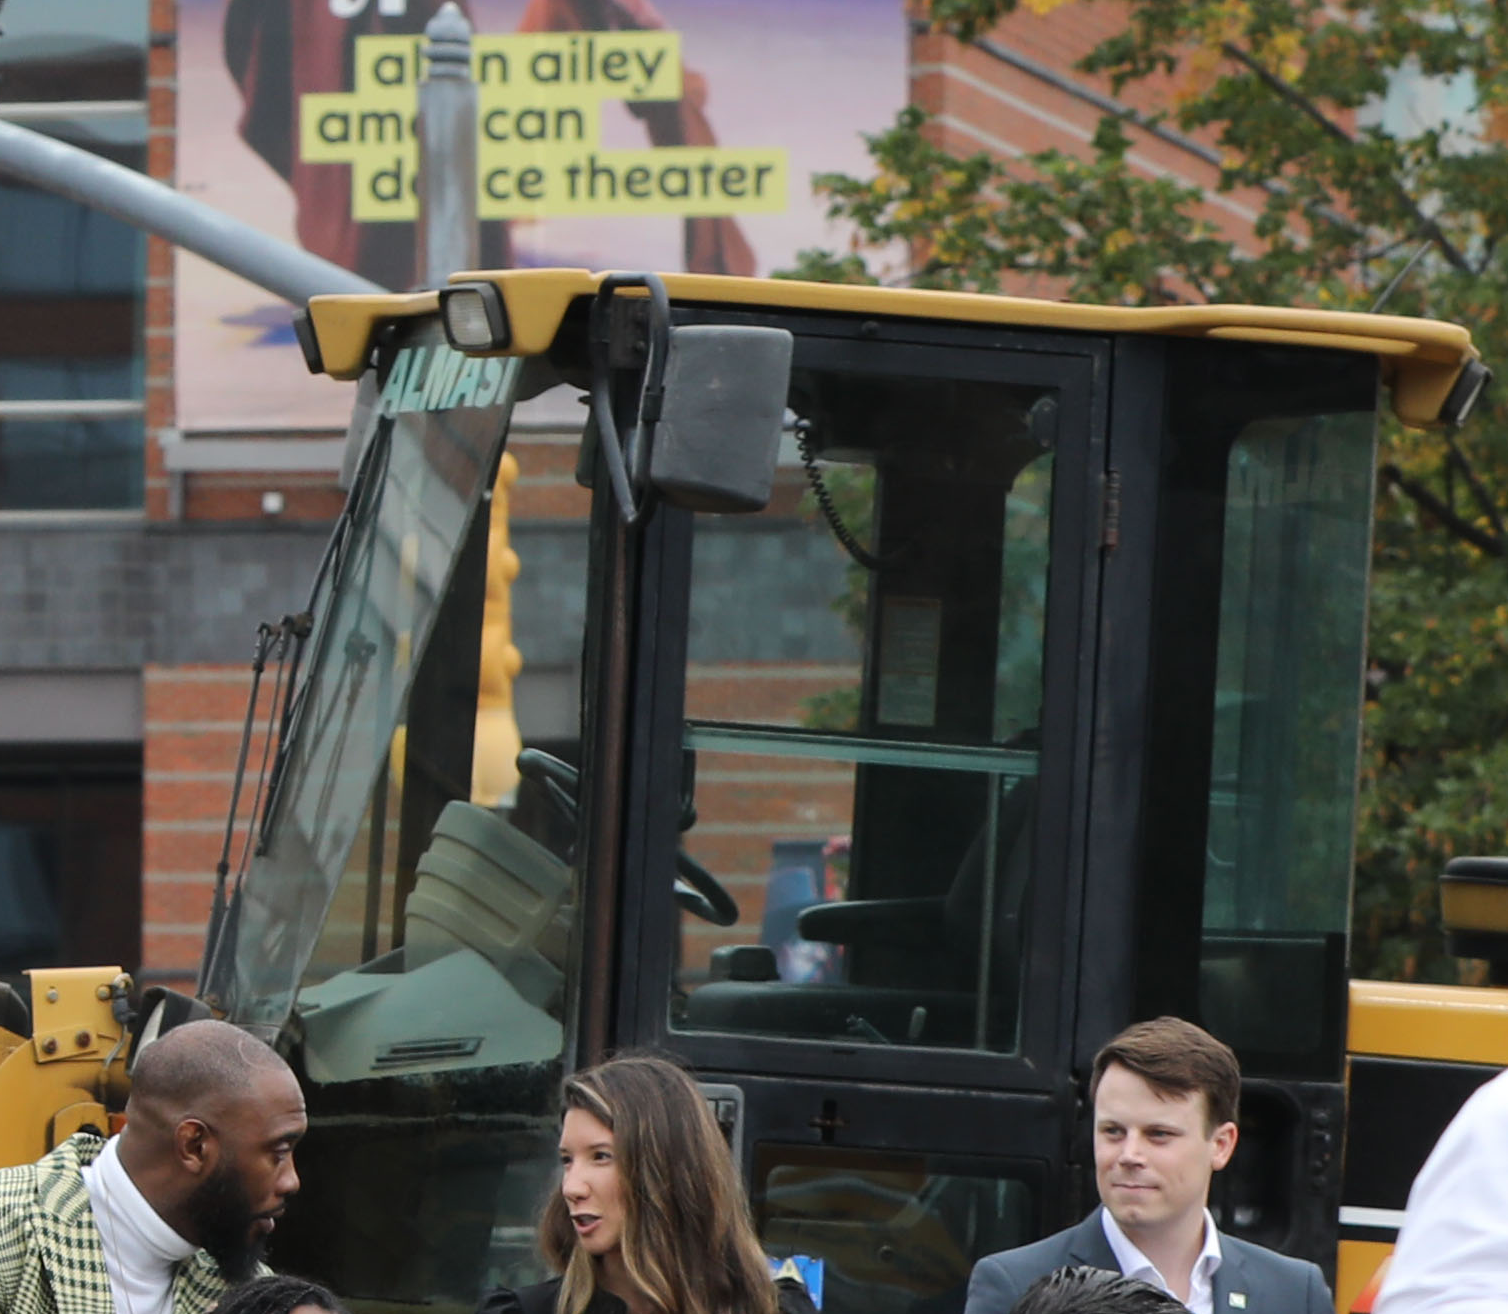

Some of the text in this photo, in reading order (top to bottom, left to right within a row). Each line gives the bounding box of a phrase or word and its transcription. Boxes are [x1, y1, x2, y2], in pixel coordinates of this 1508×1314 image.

[532, 40, 664, 93] ailey
[568, 155, 773, 200] theater
[377, 344, 519, 418] ALMASI
